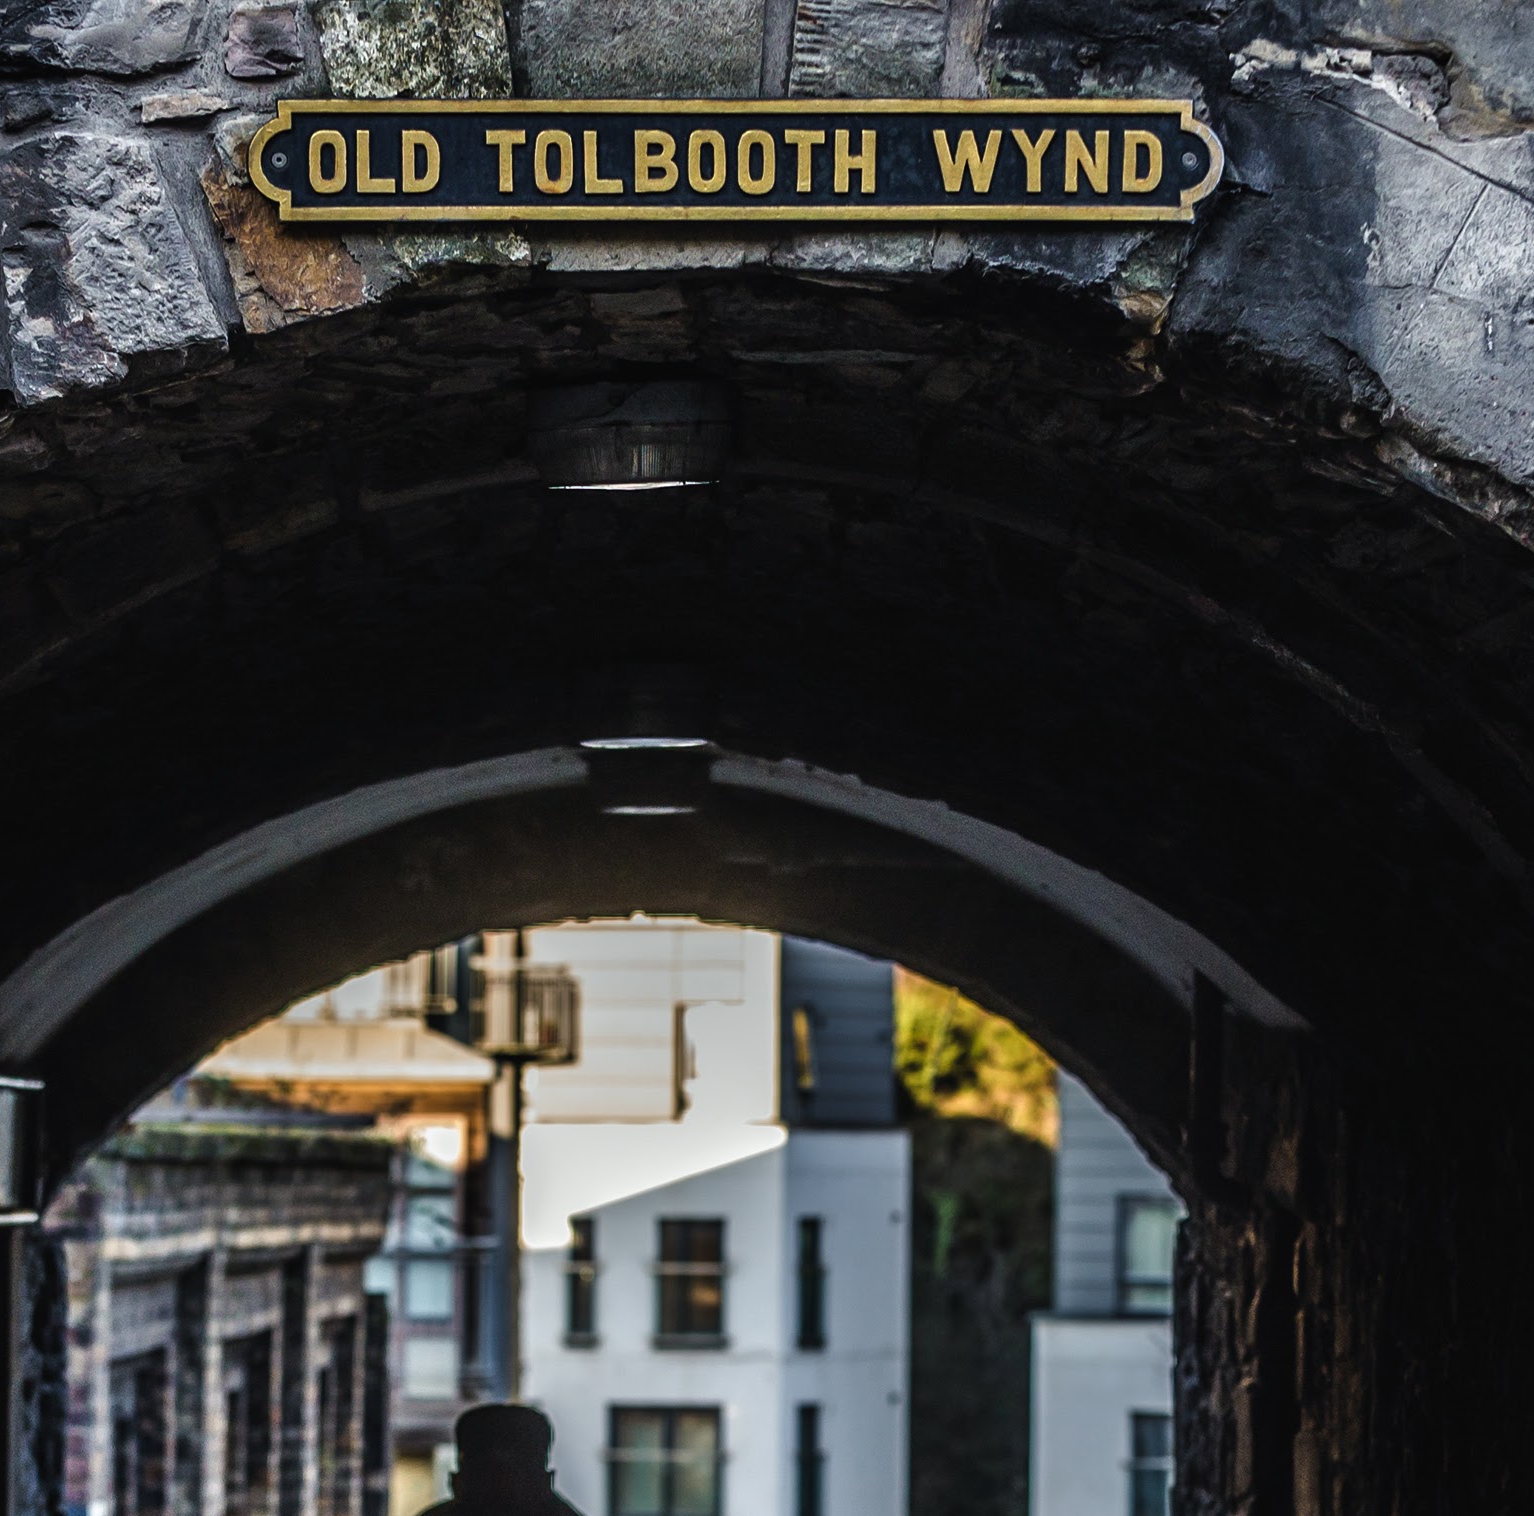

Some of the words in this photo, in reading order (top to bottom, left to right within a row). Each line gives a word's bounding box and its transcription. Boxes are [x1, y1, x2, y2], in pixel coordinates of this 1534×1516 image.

[308, 129, 441, 194] OLD
[486, 129, 877, 195] TOLBOOTH
[933, 129, 1163, 193] WYND
